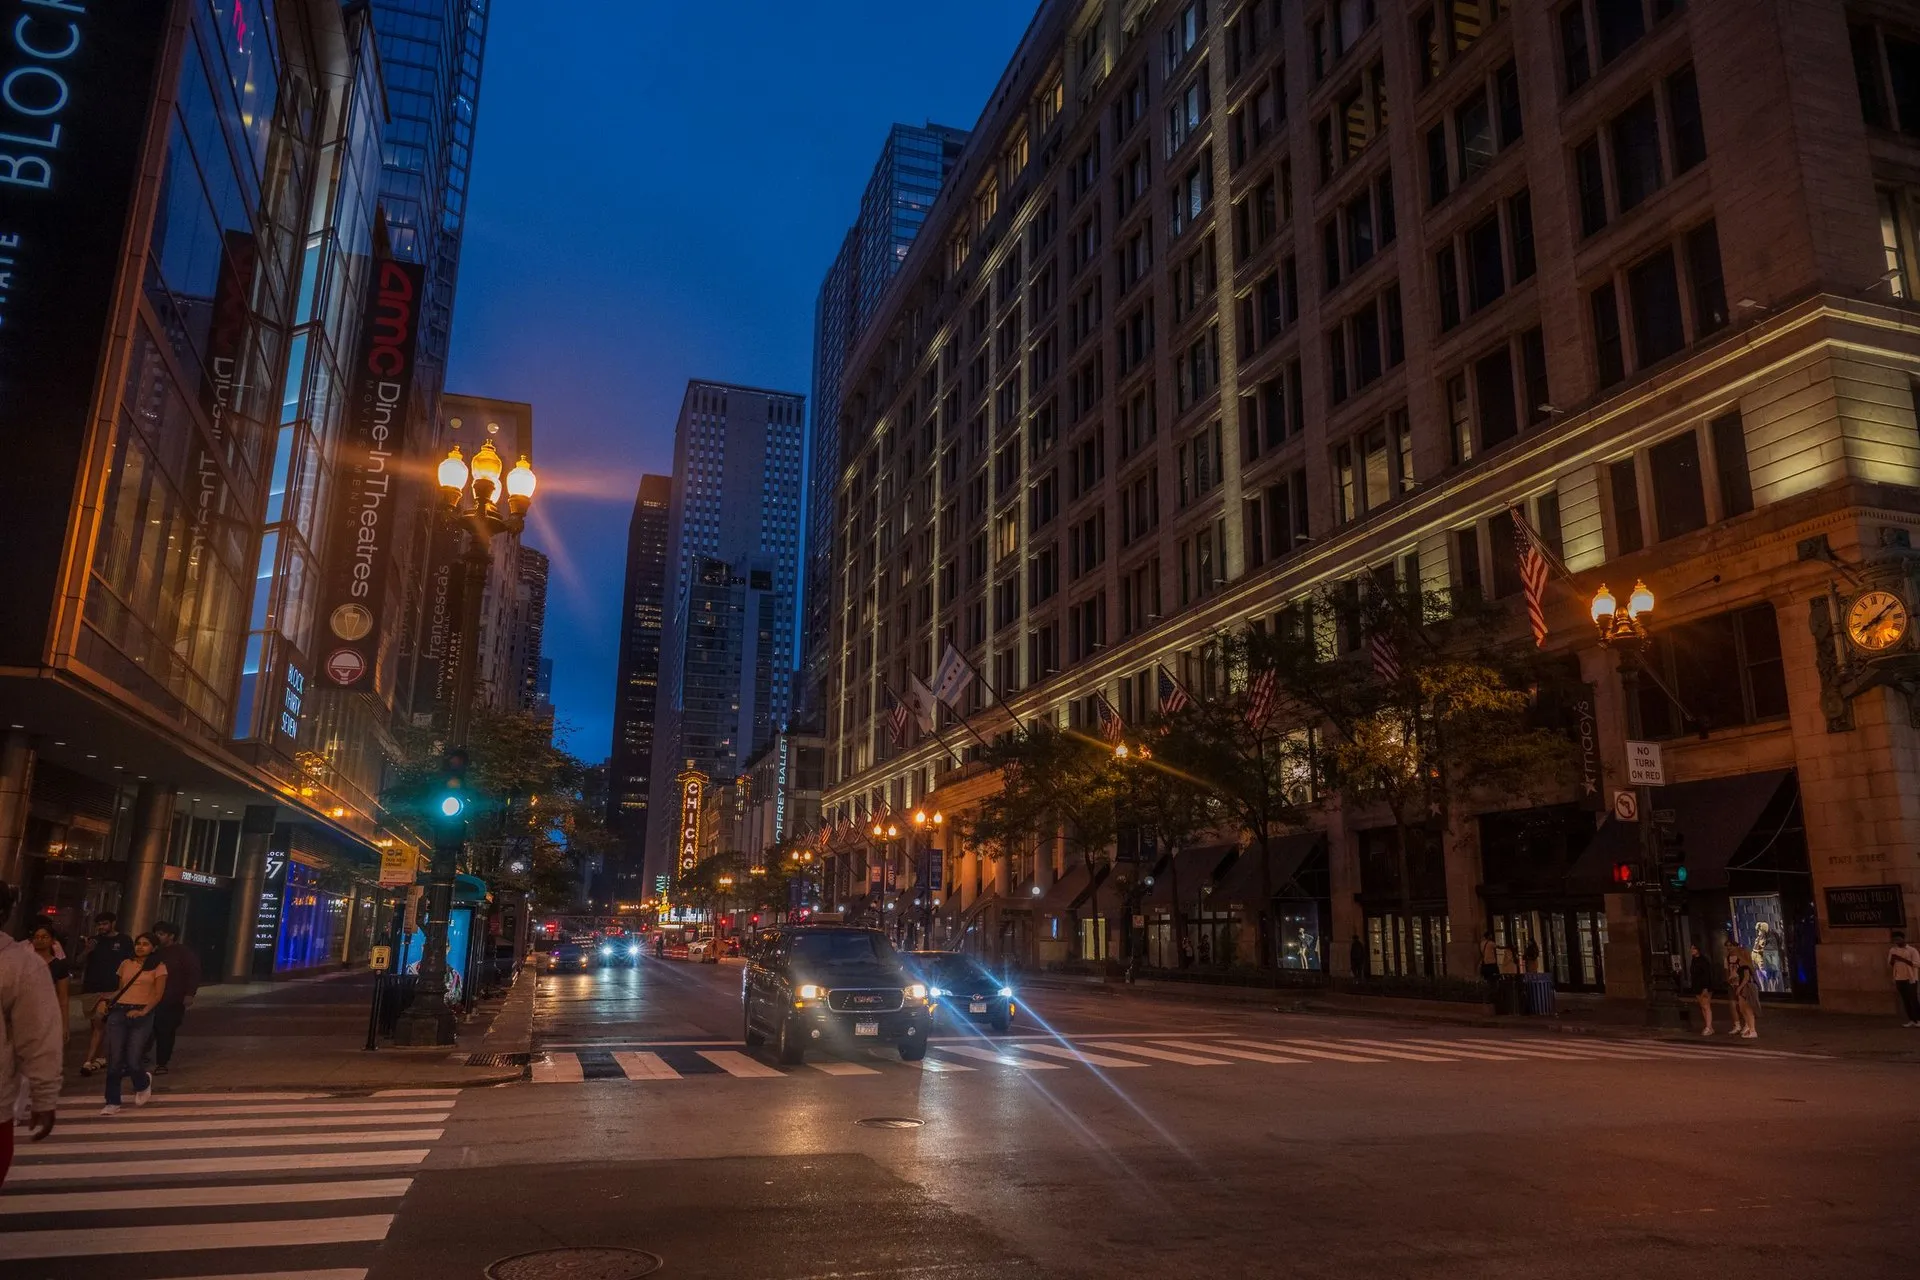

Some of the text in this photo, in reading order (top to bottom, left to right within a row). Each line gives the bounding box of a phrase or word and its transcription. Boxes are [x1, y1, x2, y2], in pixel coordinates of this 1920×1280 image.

[368, 260, 413, 377] amc
[346, 464, 362, 528] MENUS
[351, 381, 401, 599] Dine-In Theatres
[421, 564, 449, 660] francesca's
[288, 663, 304, 695] BLOCK
[446, 631, 458, 680] FACTORY
[281, 711, 298, 740] SEVEN
[285, 687, 302, 717] THIRTY
[778, 736, 789, 785] BALLET
[1572, 700, 1597, 776] macy's
[1637, 746, 1650, 756] NO
[1631, 770, 1661, 780] ON RED
[1634, 758, 1656, 768] TURN
[682, 782, 699, 878] CHICAG
[1843, 909, 1882, 922] COMPANY
